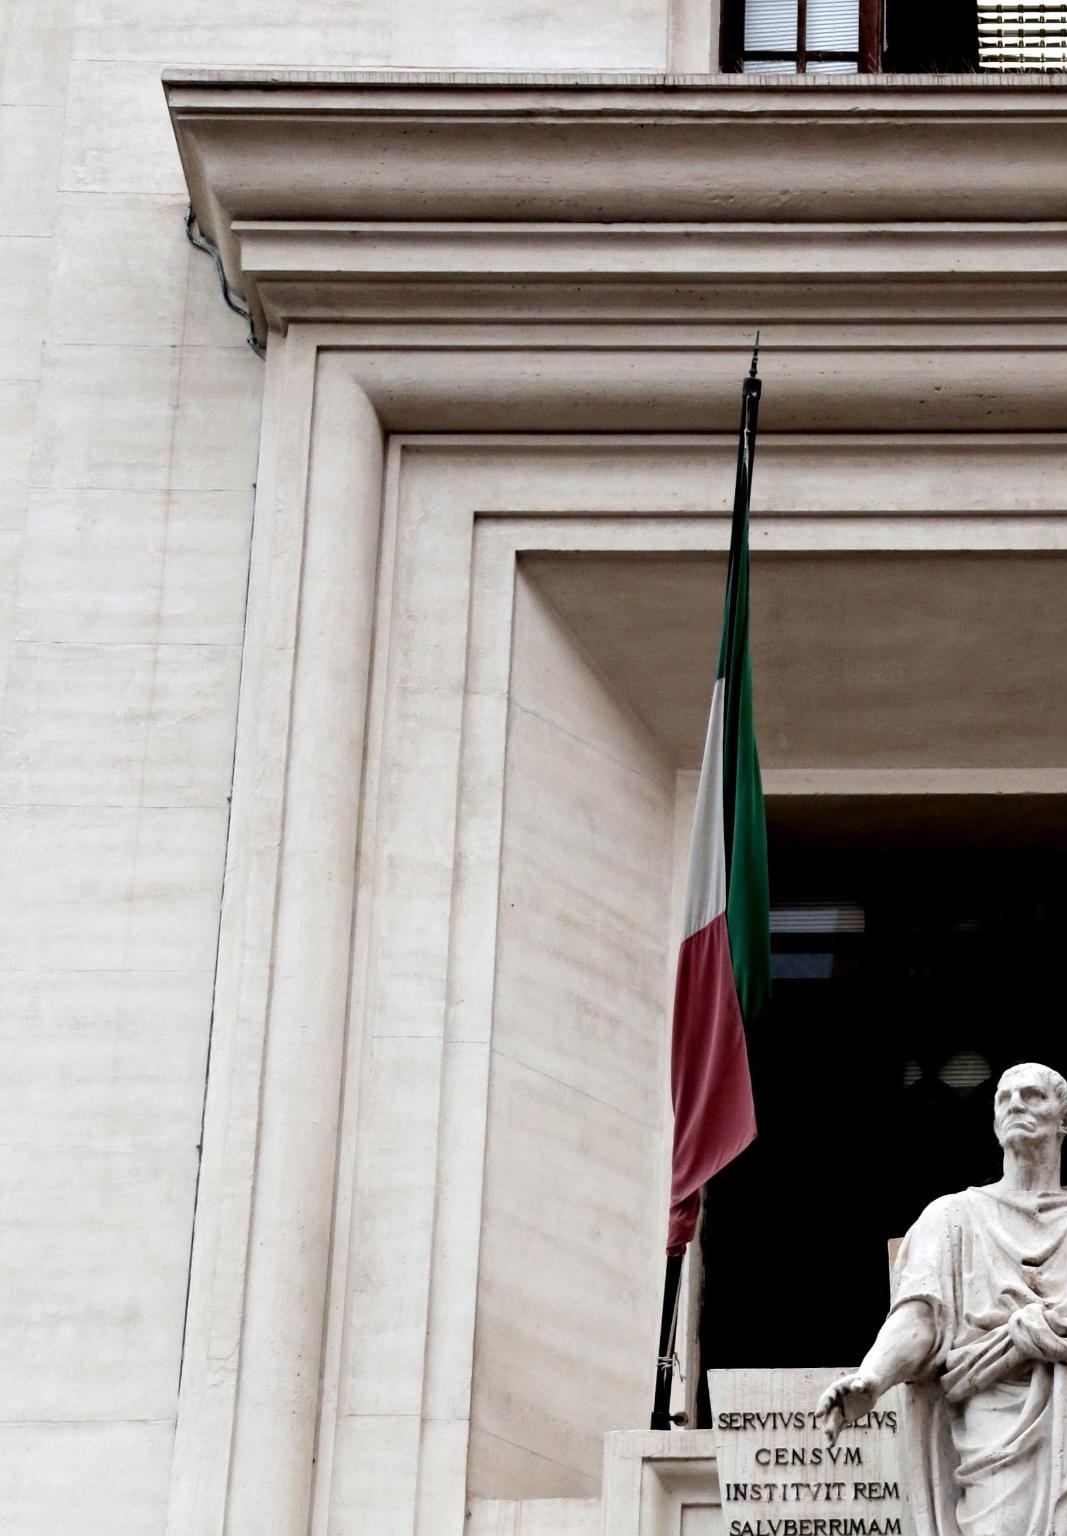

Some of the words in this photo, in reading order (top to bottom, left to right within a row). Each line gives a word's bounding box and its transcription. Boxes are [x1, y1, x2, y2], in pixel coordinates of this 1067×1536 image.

[718, 1411, 805, 1430] SERVIVS
[755, 1447, 863, 1466] CENSVM
[725, 1483, 846, 1501] INSTITVIT
[853, 1482, 900, 1500] REM
